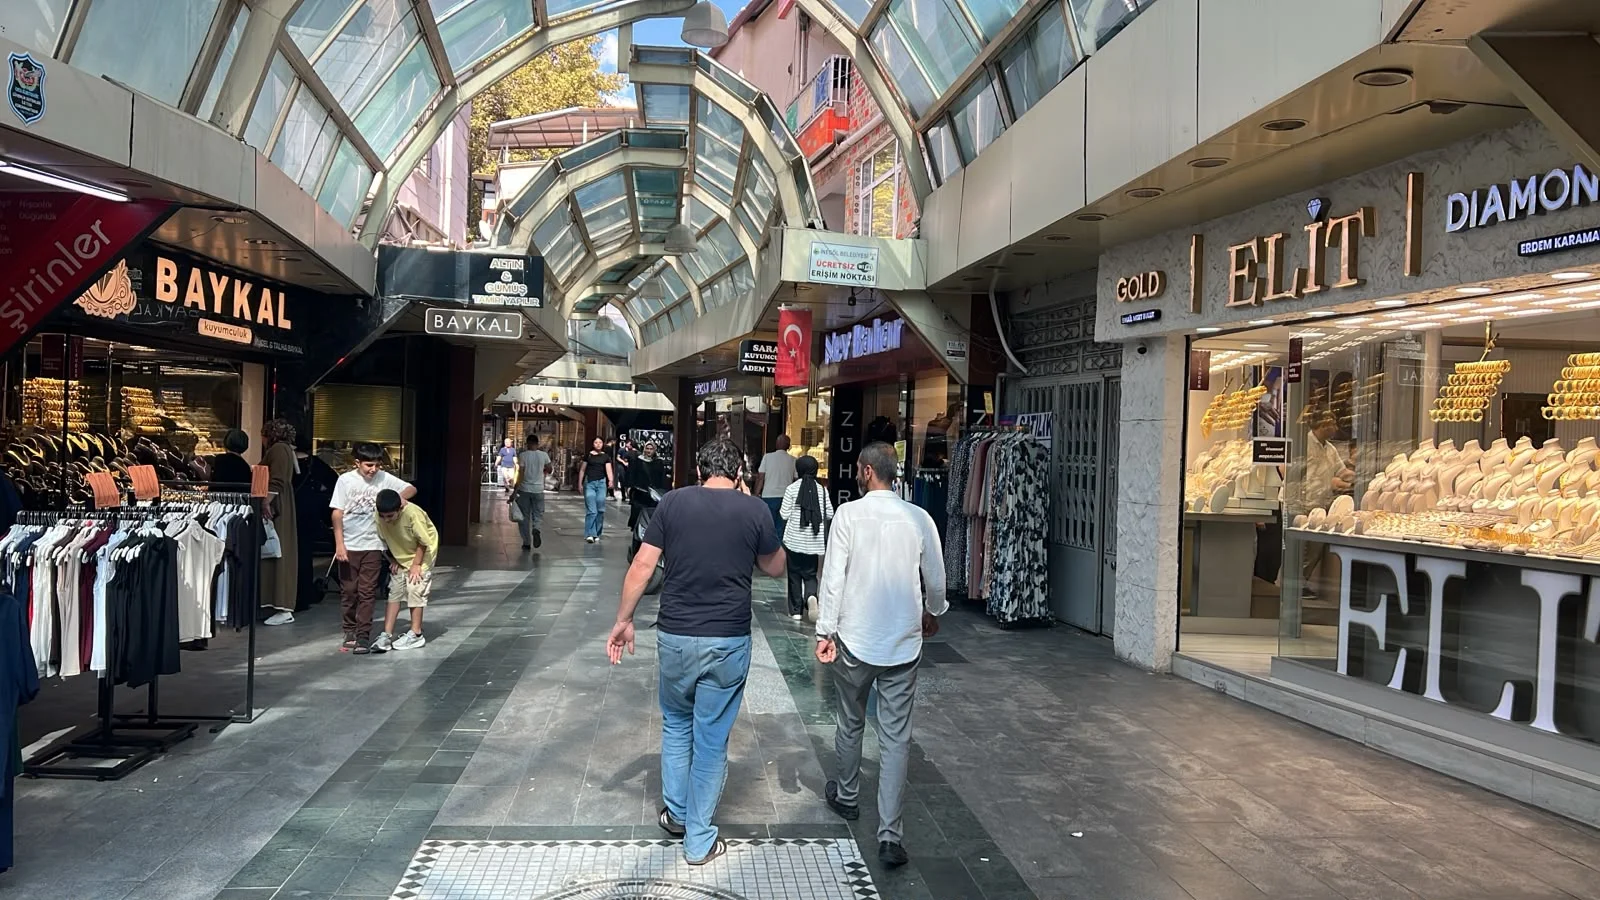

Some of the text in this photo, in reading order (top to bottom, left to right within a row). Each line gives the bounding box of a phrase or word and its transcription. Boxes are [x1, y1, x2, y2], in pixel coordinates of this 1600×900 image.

[1446, 164, 1599, 232] DIAMON
[1520, 238, 1553, 254] ERDEM
[489, 258, 524, 270] ALTIN
[816, 259, 855, 270] ÜCRETSİZ
[0, 219, 111, 334] Şirinler
[501, 271, 512, 282] &
[811, 269, 875, 282] ERİŞİM NOKTASI
[156, 256, 292, 330] BAYKAL
[484, 281, 528, 296] GÜMÜŞ
[1116, 271, 1160, 302] GOLD
[505, 296, 540, 307] YAPILIR
[204, 321, 247, 338] kuyumculuk
[434, 314, 513, 332] BAYKAL
[752, 344, 778, 353] SARA
[742, 364, 765, 372] ADEM
[837, 411, 854, 505] ZÜHR
[1329, 545, 1600, 734] ELI
